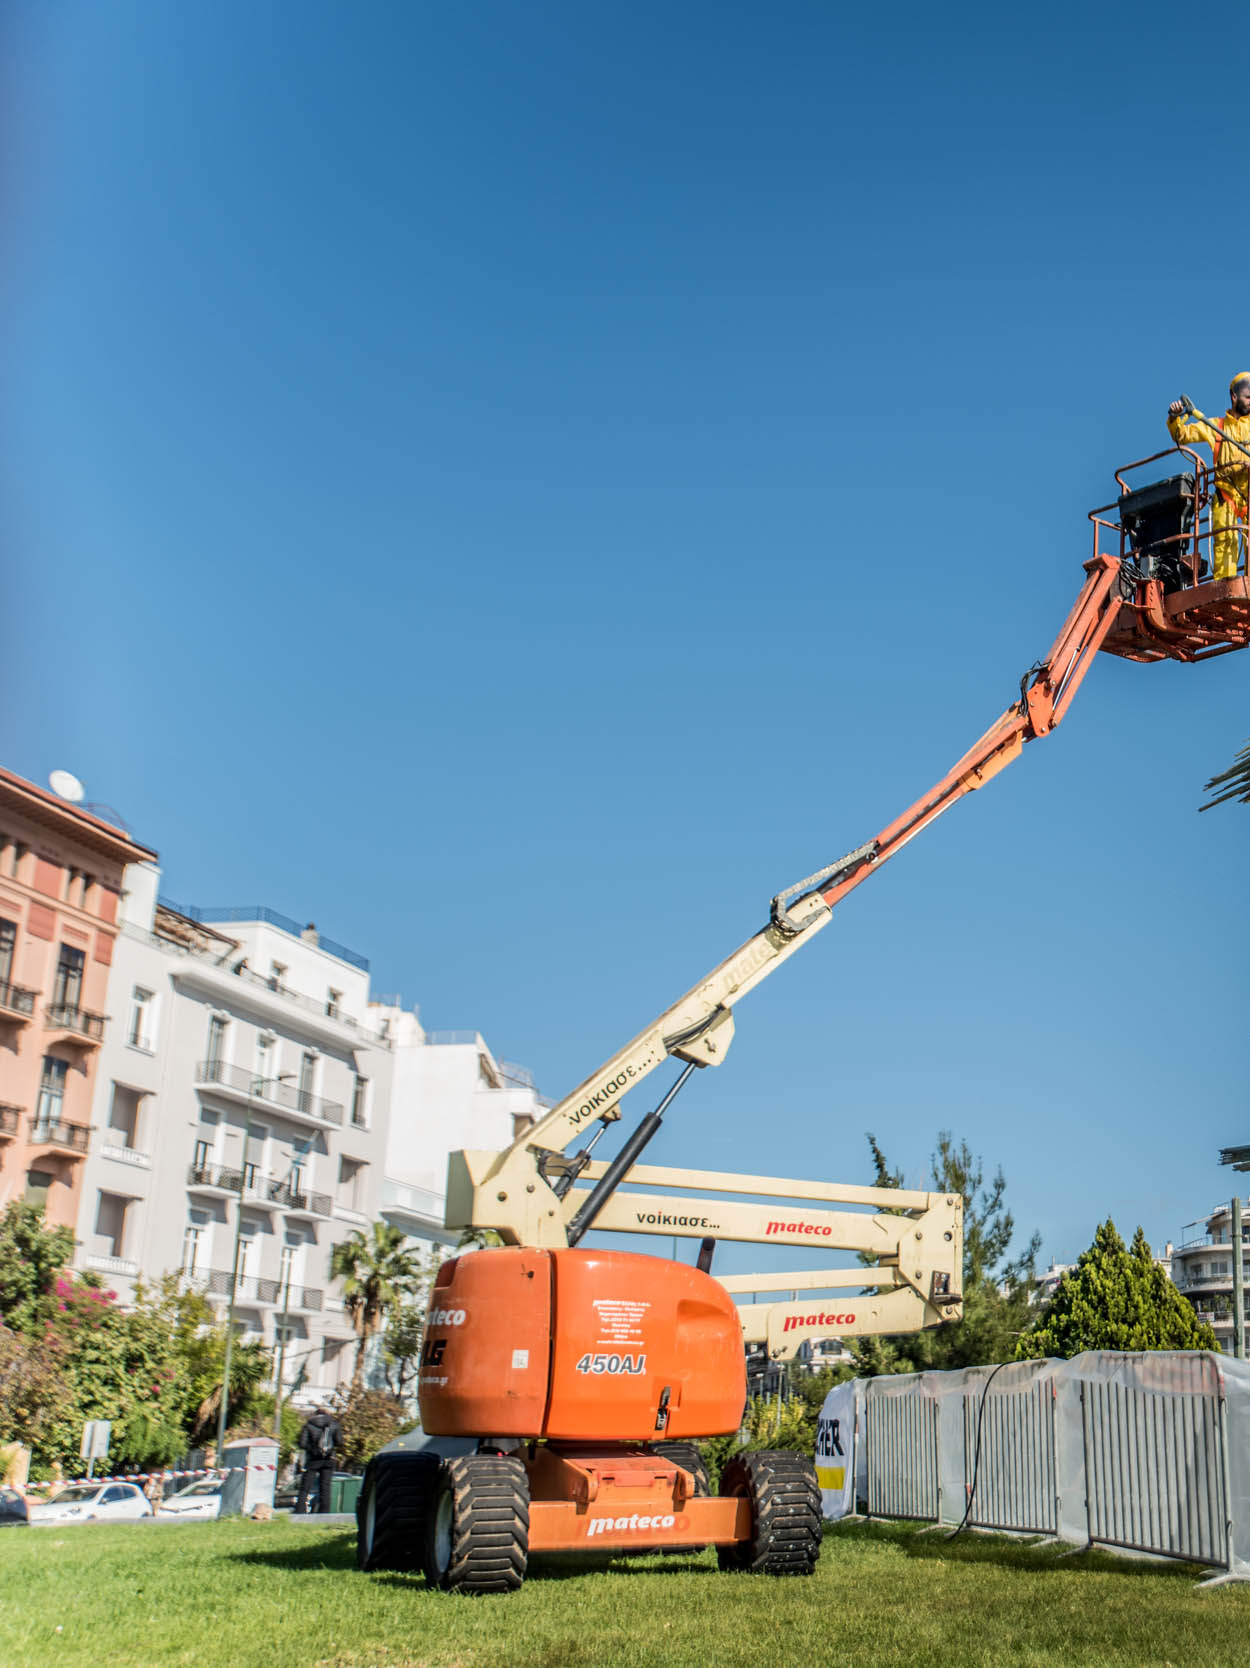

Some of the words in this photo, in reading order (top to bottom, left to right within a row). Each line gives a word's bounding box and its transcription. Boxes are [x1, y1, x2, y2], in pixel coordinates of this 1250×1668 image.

[765, 1220, 832, 1237] mateco
[783, 1311, 856, 1333] mateco
[575, 1353, 646, 1375] 450AJ
[586, 1513, 675, 1536] mateco
